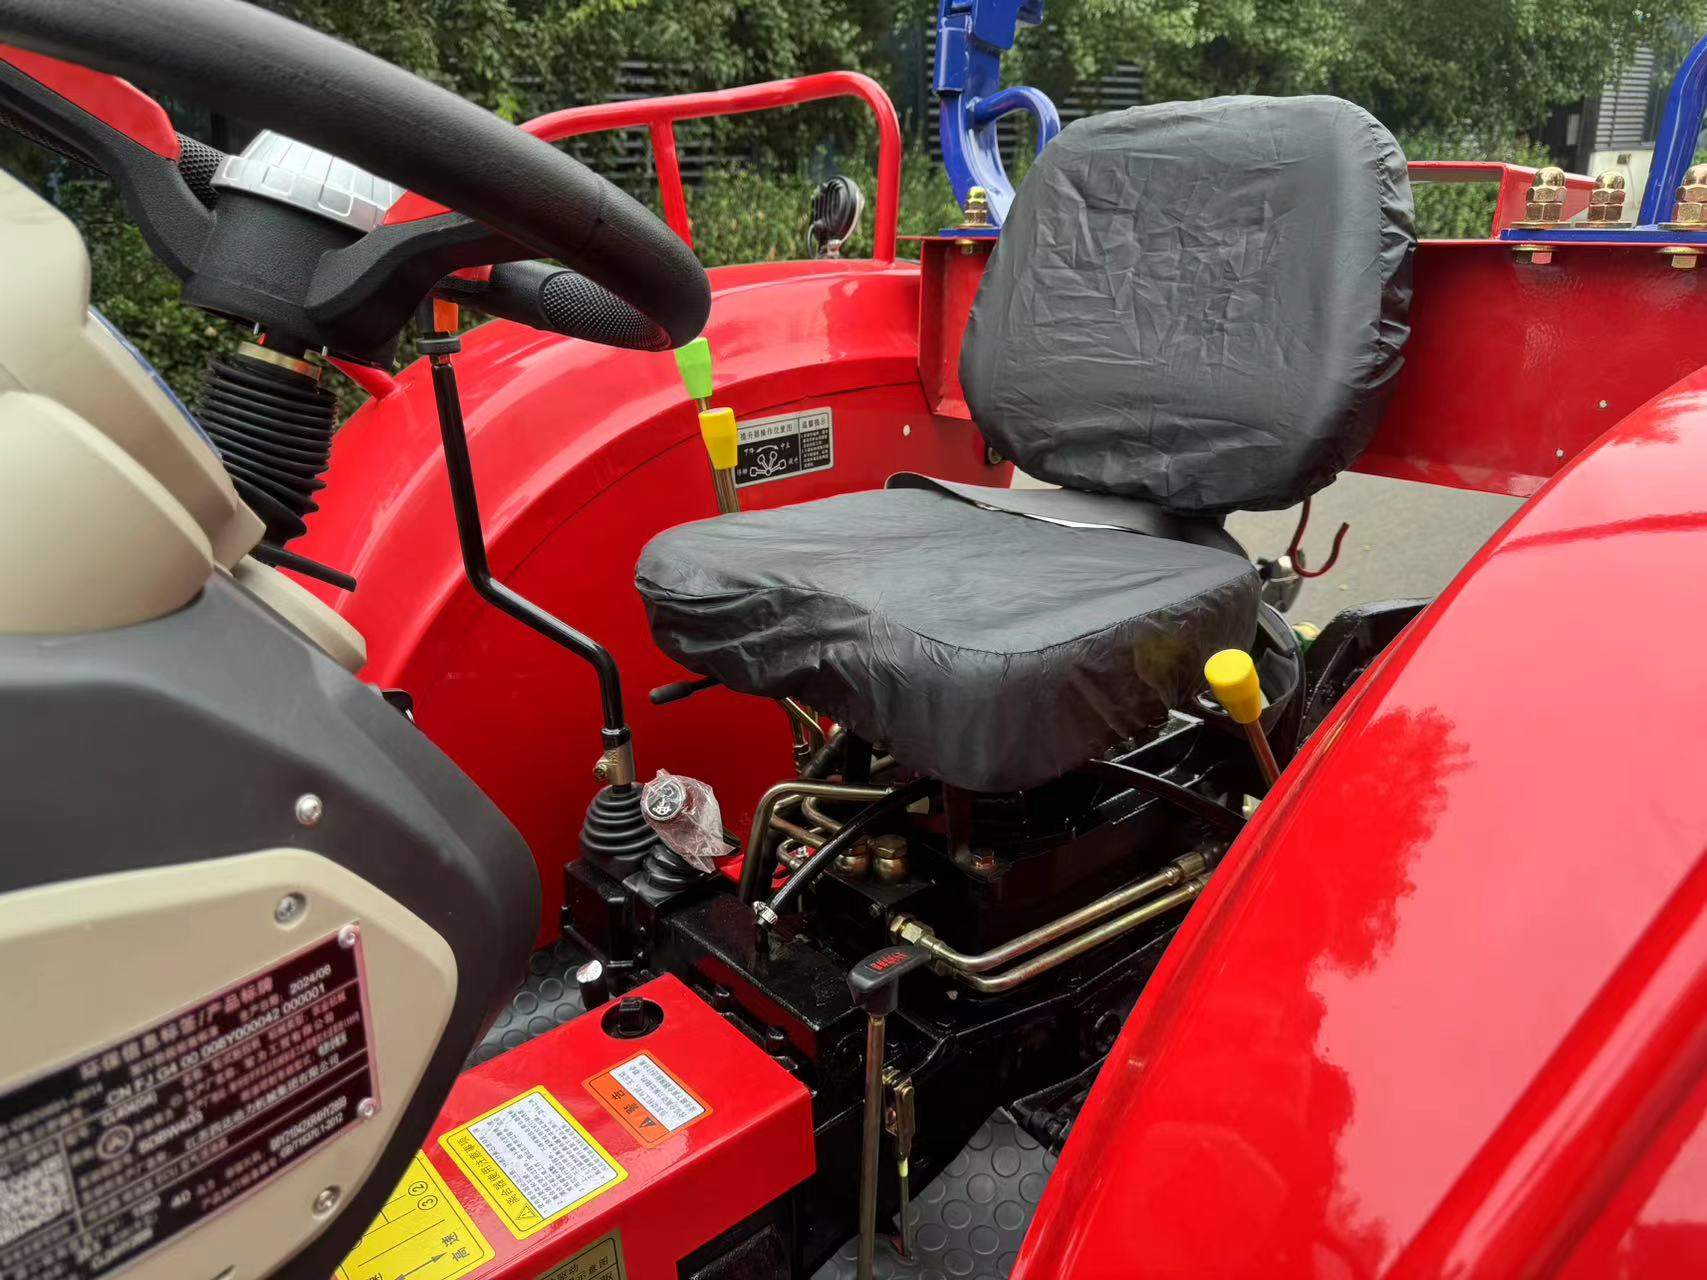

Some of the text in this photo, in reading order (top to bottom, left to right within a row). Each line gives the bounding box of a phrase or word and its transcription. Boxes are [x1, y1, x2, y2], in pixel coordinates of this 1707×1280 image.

[106, 1083, 133, 1105] CN
[156, 1061, 178, 1080] G4
[611, 1089, 639, 1115] 警告
